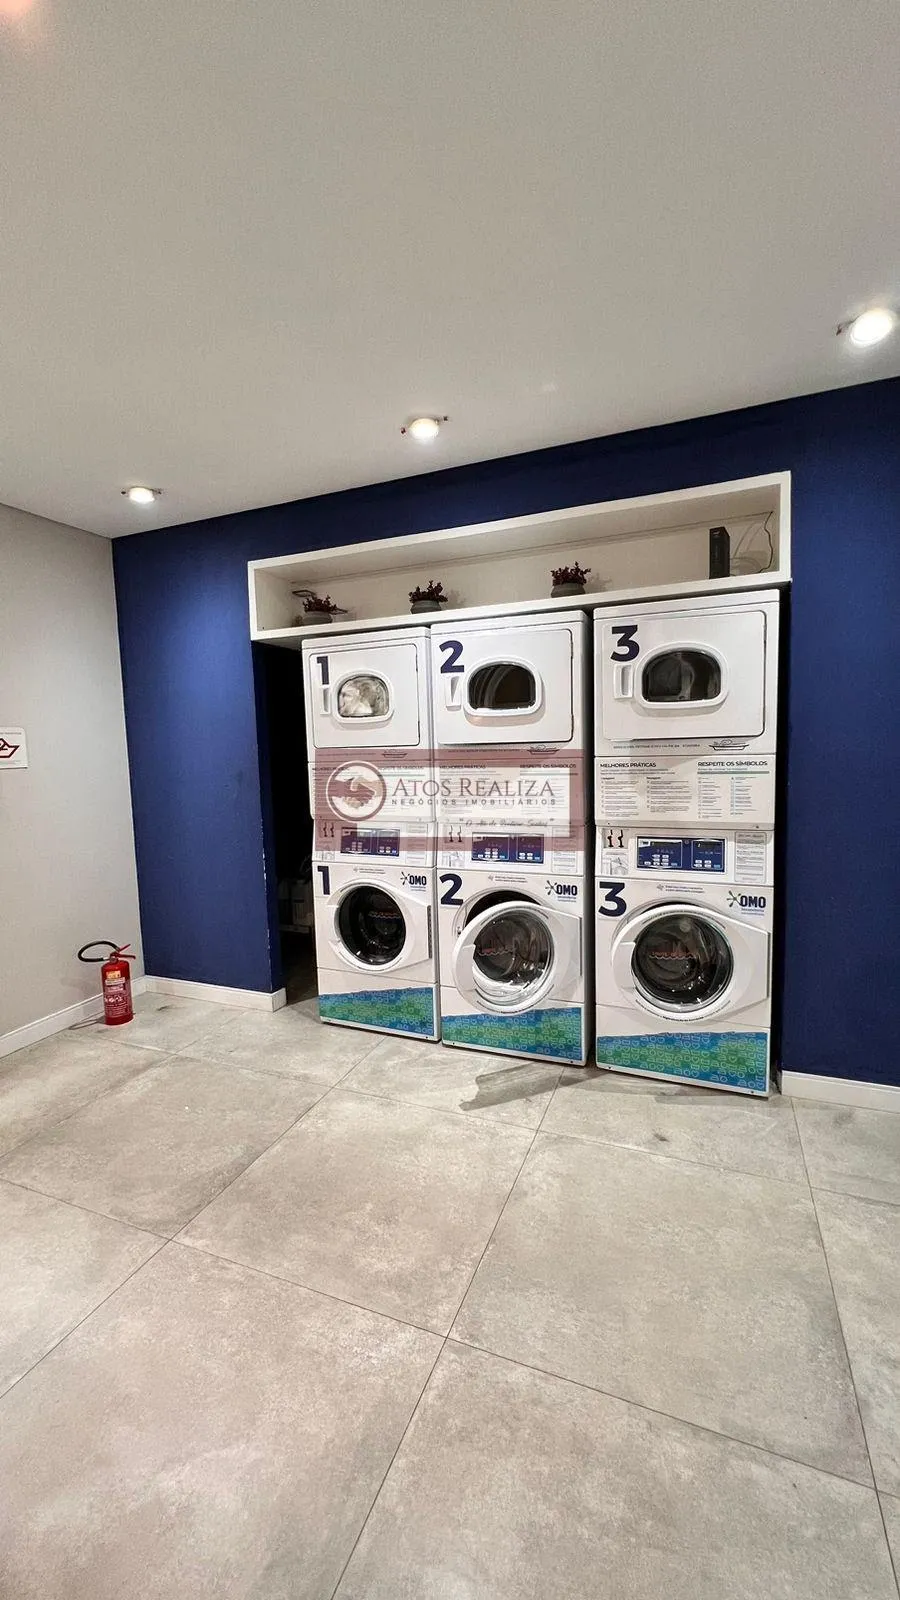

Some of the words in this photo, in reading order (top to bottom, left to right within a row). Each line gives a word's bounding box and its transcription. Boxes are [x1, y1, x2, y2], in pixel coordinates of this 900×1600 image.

[439, 640, 465, 674] 2
[610, 624, 640, 662] 3
[316, 656, 329, 685] 1
[317, 866, 331, 896] 1
[409, 875, 427, 886] OMO
[439, 873, 464, 906] 2
[556, 884, 578, 896] OMO
[598, 881, 627, 917] 3
[740, 895, 767, 908] OMO
